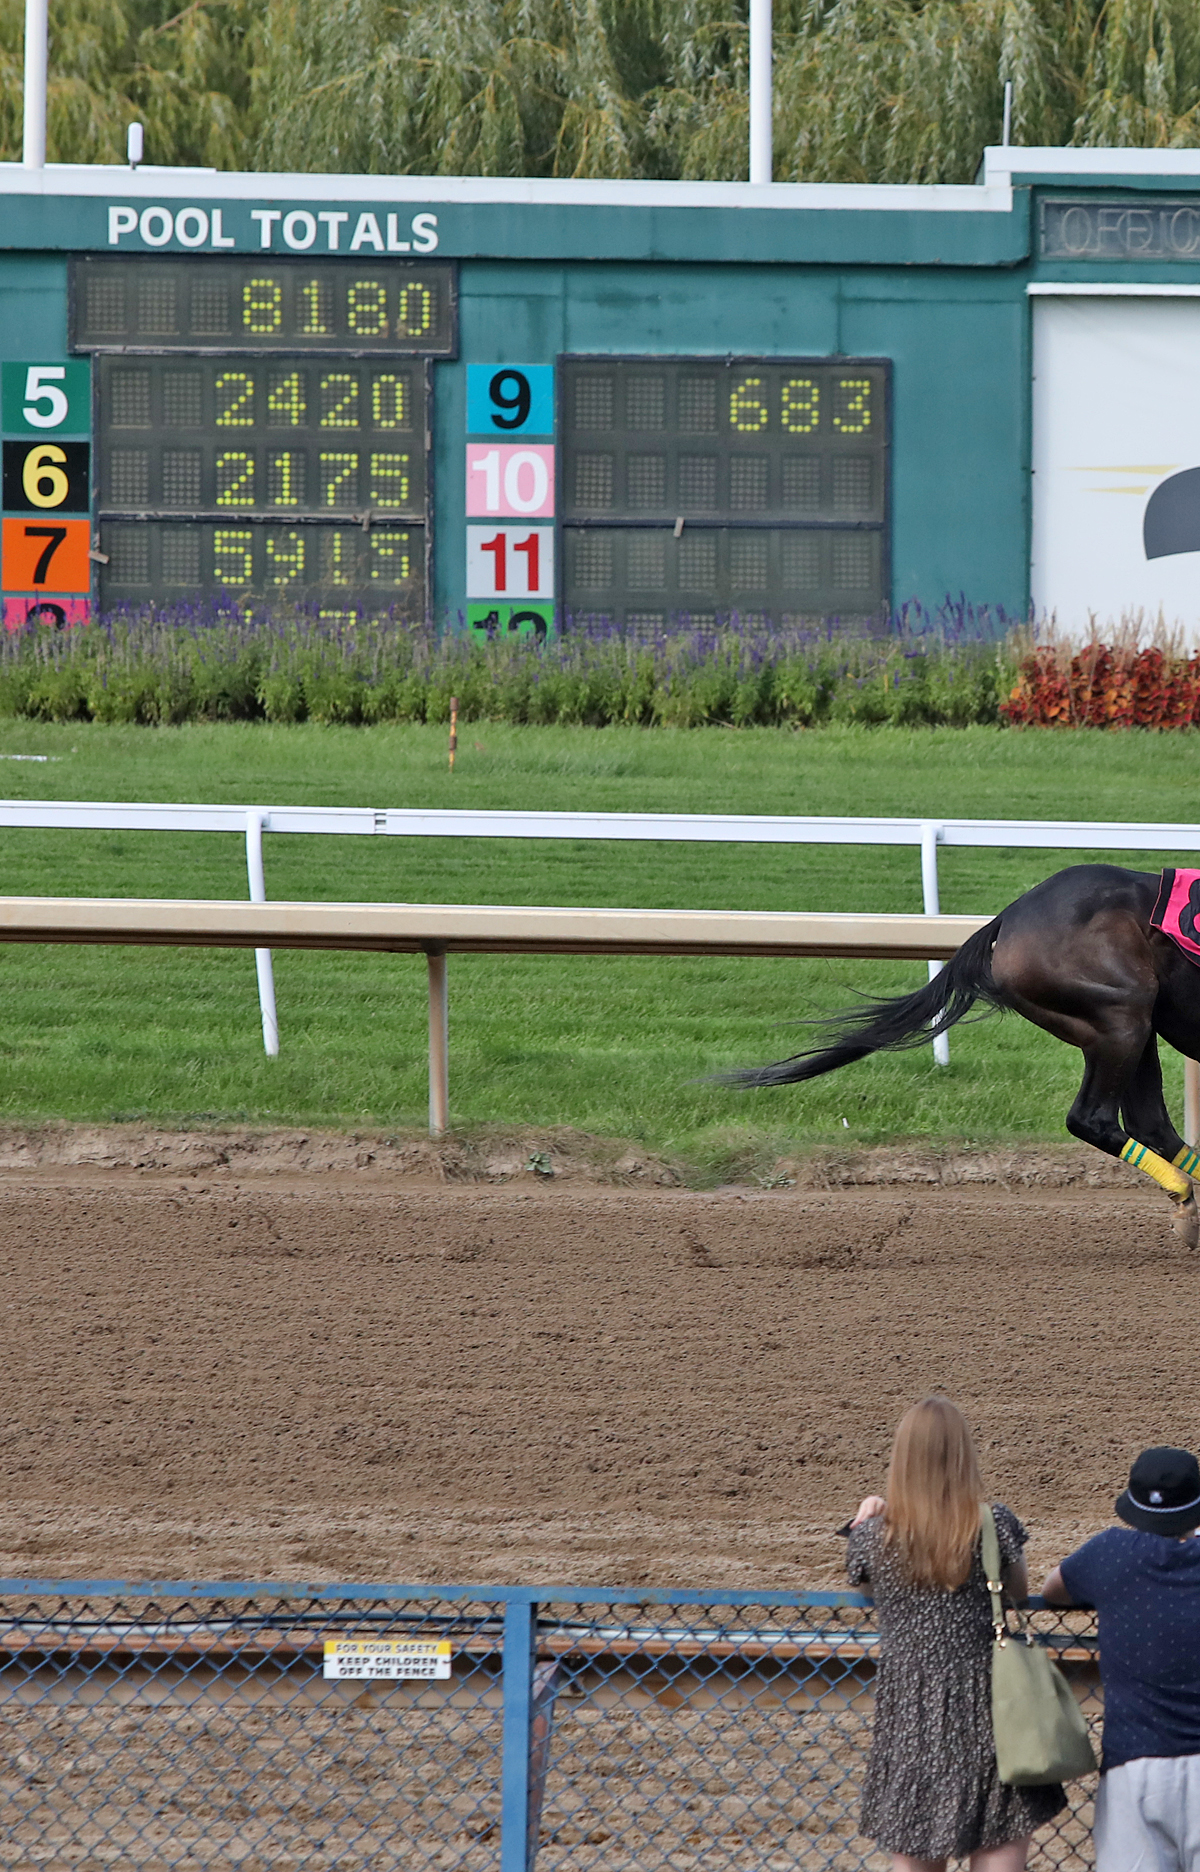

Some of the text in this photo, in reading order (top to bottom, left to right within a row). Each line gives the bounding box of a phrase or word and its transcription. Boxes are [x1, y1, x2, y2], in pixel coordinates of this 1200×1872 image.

[108, 206, 439, 253] POOL TOTALS
[243, 279, 431, 336] 8180
[22, 366, 69, 428] 5
[215, 372, 403, 428] 2420
[489, 370, 531, 429] 9
[730, 378, 871, 433] 683
[22, 445, 69, 508] 6
[215, 452, 408, 507] 2175
[472, 450, 549, 513] 10
[24, 527, 67, 584] 7
[214, 531, 409, 585] 5915
[480, 533, 539, 591] 11
[336, 1644, 437, 1654] FOR YOUR SAFETY
[337, 1657, 438, 1666] KEEP CHILDREN
[339, 1667, 436, 1676] OFF THE FENCE
